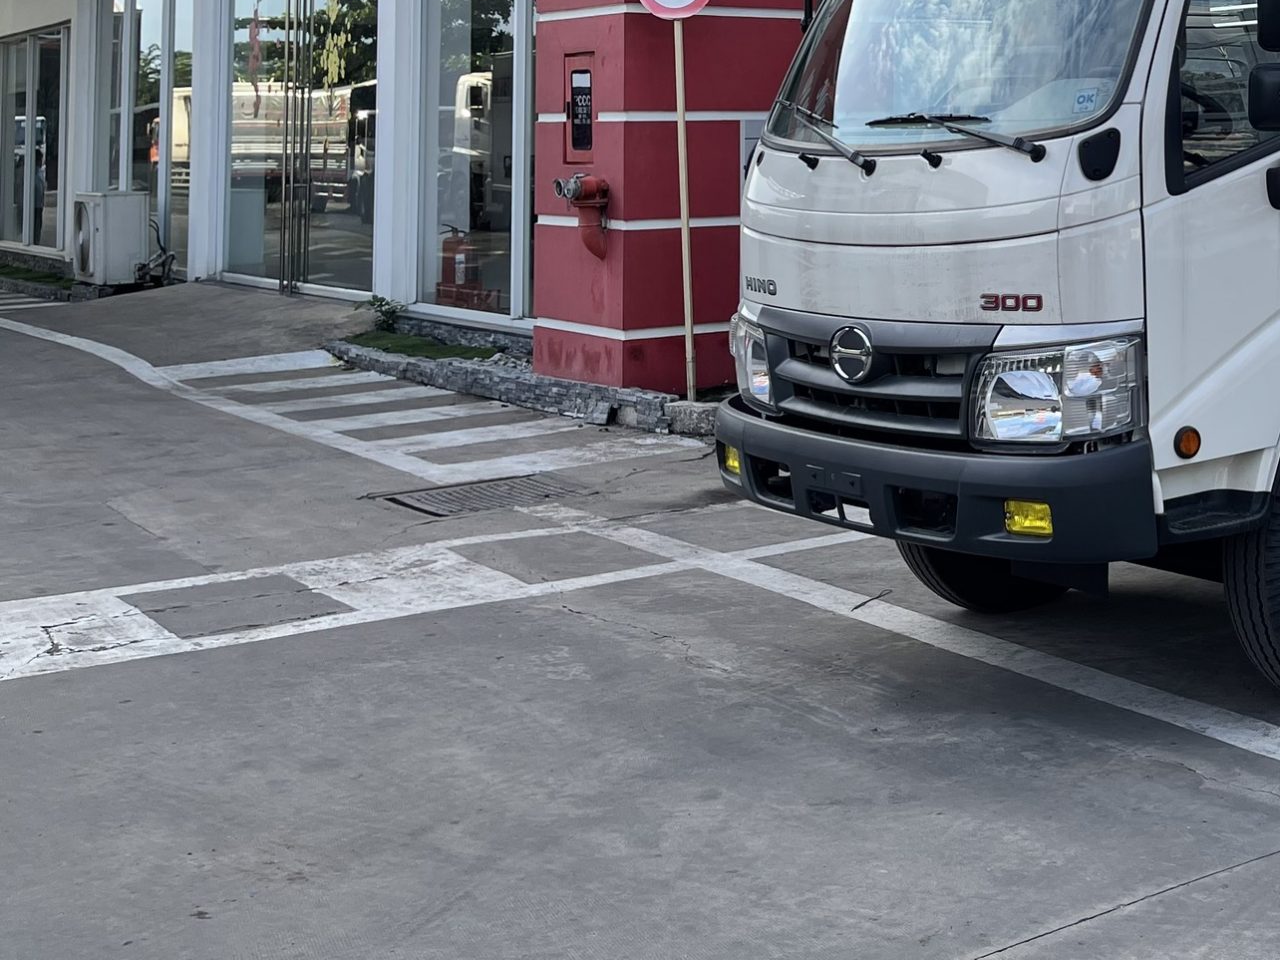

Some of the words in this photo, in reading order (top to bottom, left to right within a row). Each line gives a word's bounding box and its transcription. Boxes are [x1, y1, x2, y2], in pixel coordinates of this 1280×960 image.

[1077, 93, 1095, 105] OK
[745, 275, 777, 296] HINO
[980, 293, 1044, 312] 300
